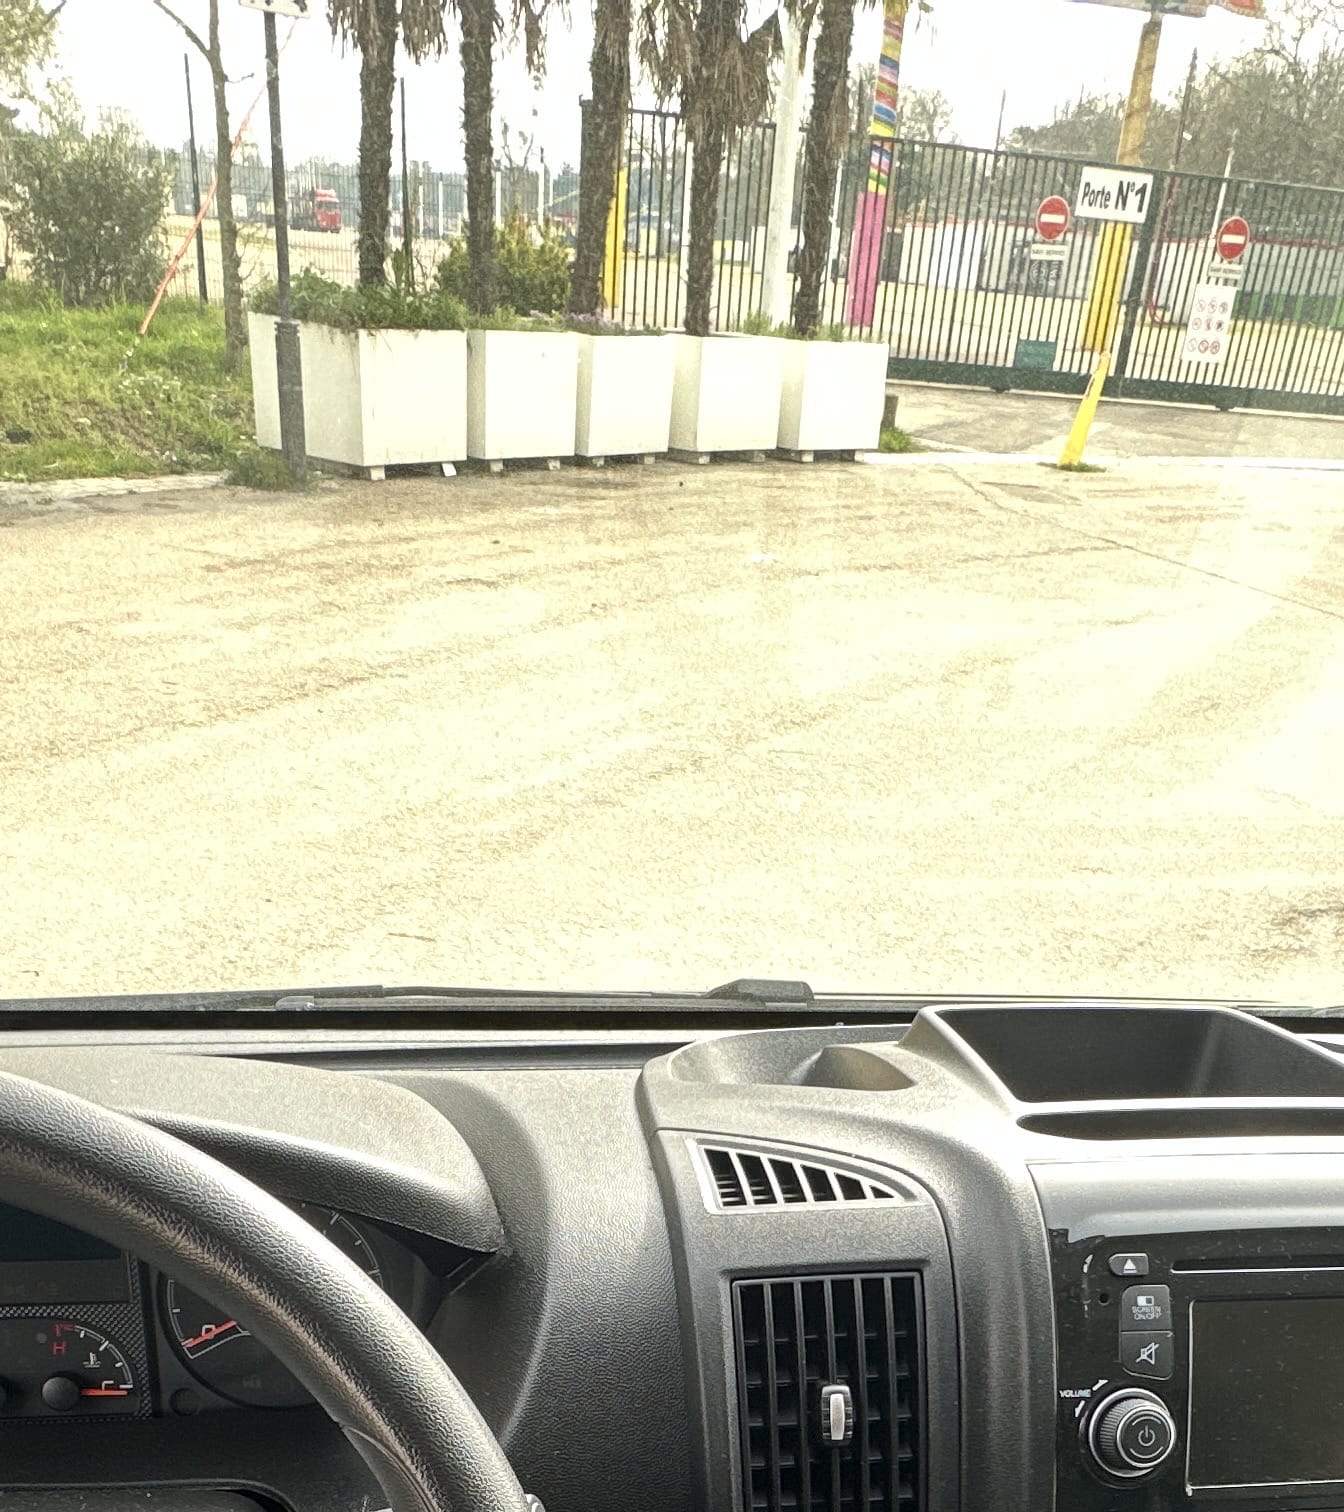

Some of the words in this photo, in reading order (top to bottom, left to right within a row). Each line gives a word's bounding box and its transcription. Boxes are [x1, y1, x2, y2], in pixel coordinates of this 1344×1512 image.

[1081, 181, 1111, 209] Porte
[52, 1342, 67, 1356] H
[1059, 1388, 1091, 1398] VOLUME
